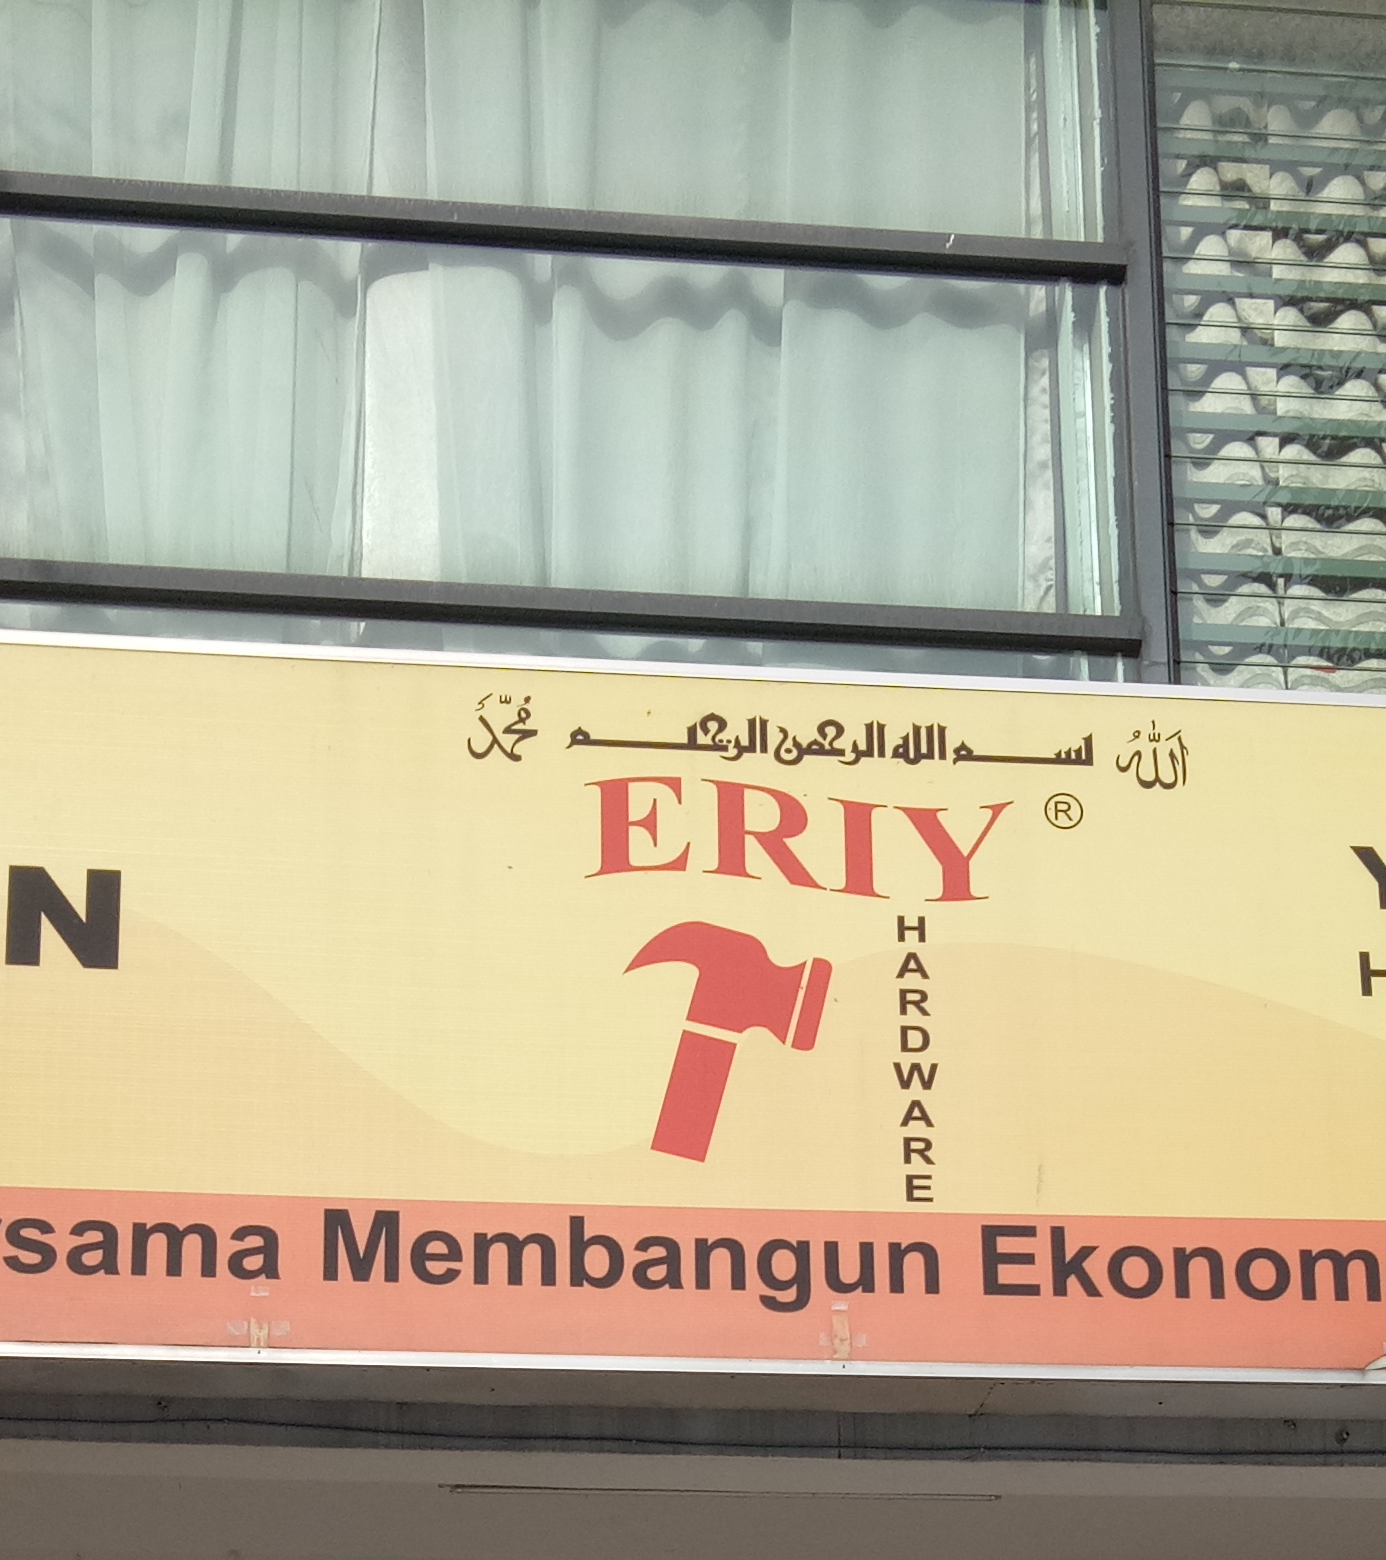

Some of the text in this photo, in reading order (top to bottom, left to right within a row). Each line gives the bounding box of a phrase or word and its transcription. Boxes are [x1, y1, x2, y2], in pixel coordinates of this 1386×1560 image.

[584, 774, 1014, 903] ERIY
[893, 915, 938, 1203] HARDWARE
[322, 1209, 940, 1312] Membangun
